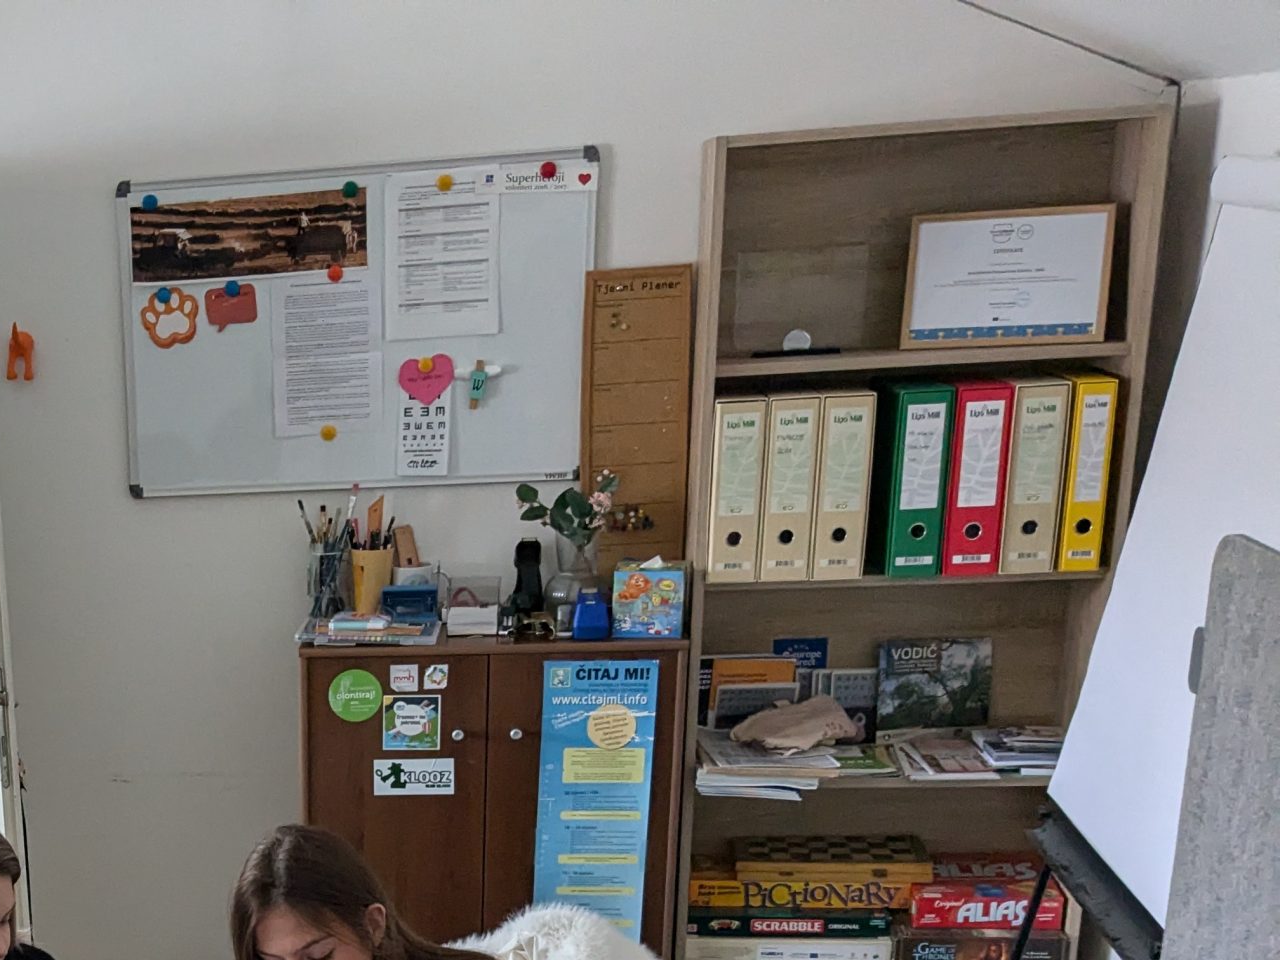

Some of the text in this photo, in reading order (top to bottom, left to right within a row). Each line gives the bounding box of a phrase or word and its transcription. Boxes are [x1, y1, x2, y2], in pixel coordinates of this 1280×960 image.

[597, 283, 635, 295] Tjeni
[575, 664, 651, 681] ČITAJ MI!
[551, 693, 648, 708] www.citajmi.info
[400, 770, 452, 784] KLOOZ
[956, 899, 1029, 927] ALIAS
[752, 921, 821, 932] SCRABBLE
